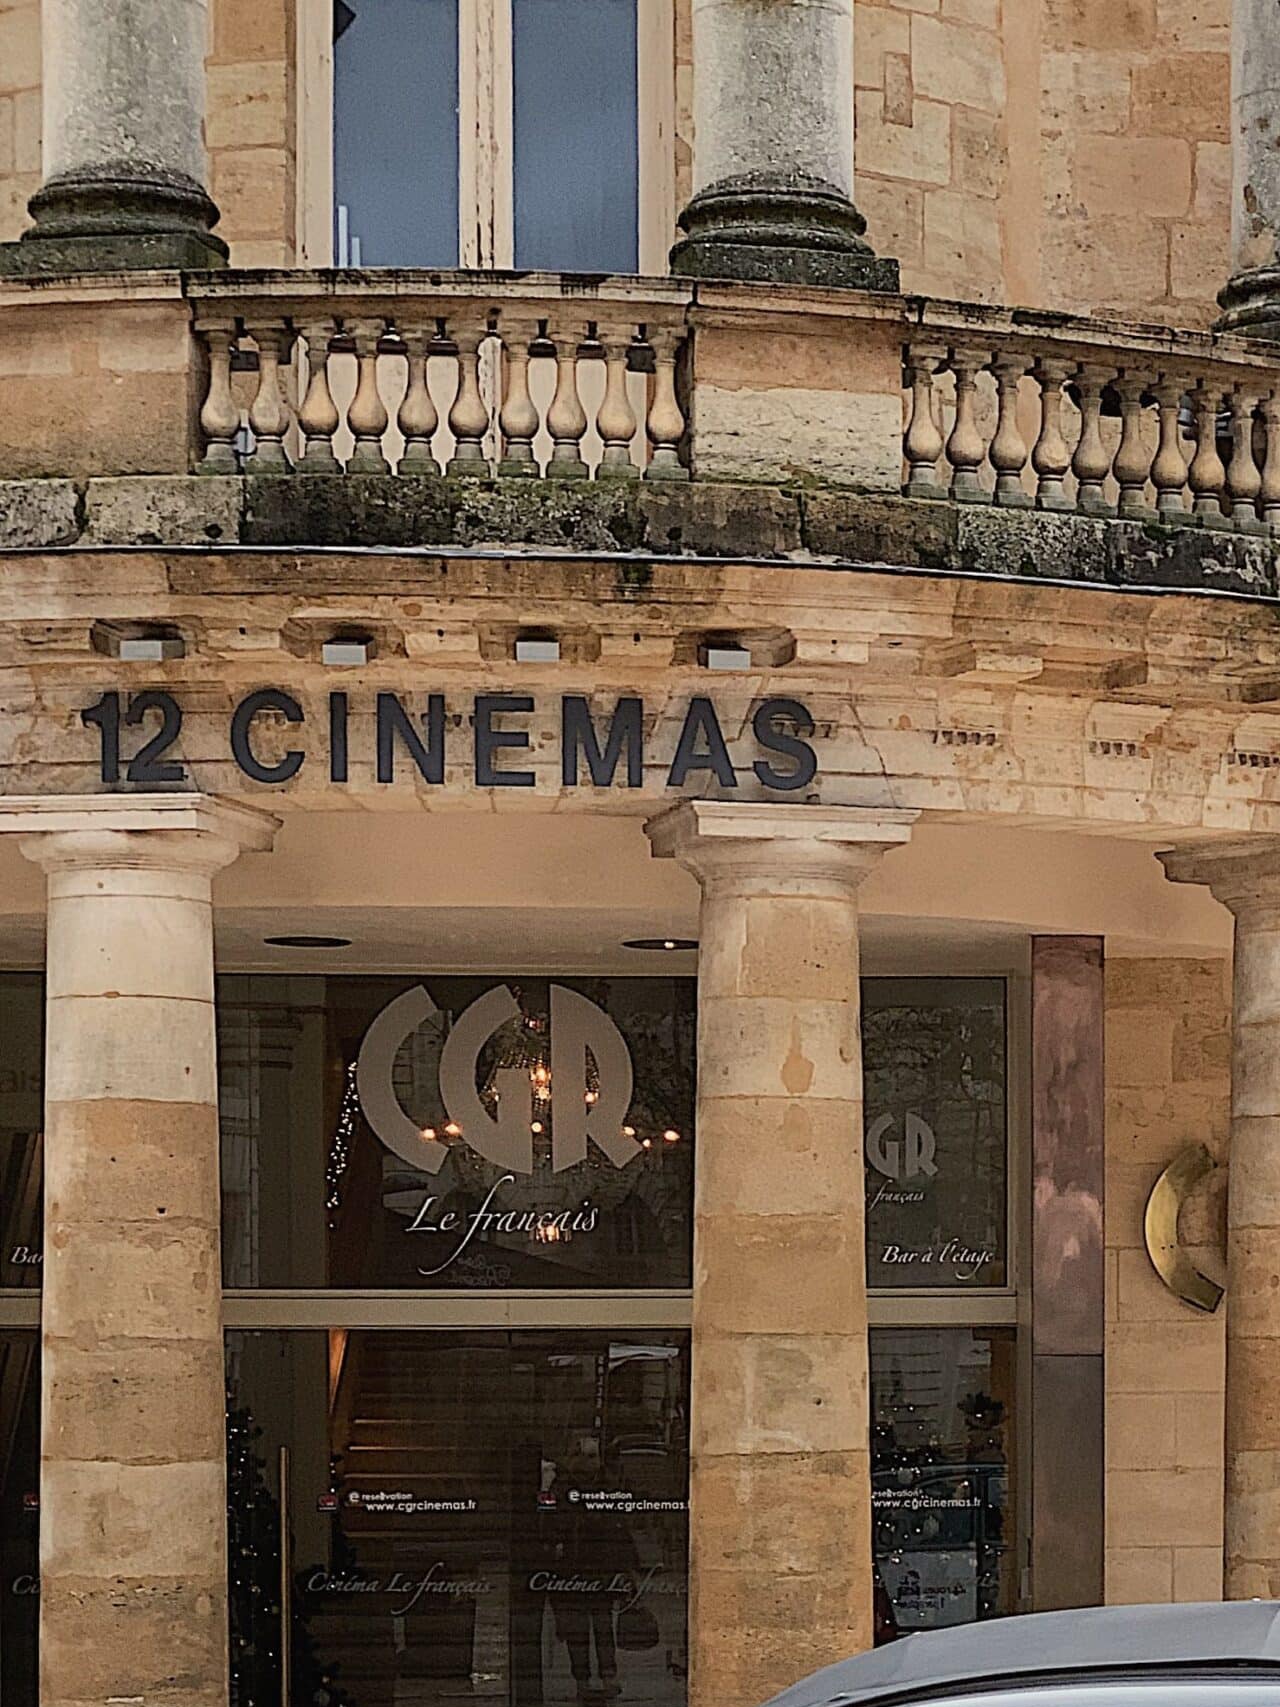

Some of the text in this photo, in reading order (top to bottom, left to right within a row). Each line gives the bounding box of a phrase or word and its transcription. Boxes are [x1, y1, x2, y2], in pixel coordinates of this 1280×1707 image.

[81, 688, 819, 791] 12 CINEMAS
[356, 983, 643, 1175] CGR
[866, 1111, 938, 1179] GR
[405, 1196, 458, 1232] Le
[418, 1175, 599, 1275] français
[882, 1246, 918, 1263] Bar
[366, 1500, 477, 1512] www.cgrcinemas.fr
[586, 1500, 690, 1512] www.cgrcinemas.
[384, 1572, 413, 1592] Le
[529, 1571, 602, 1592] Cinéma
